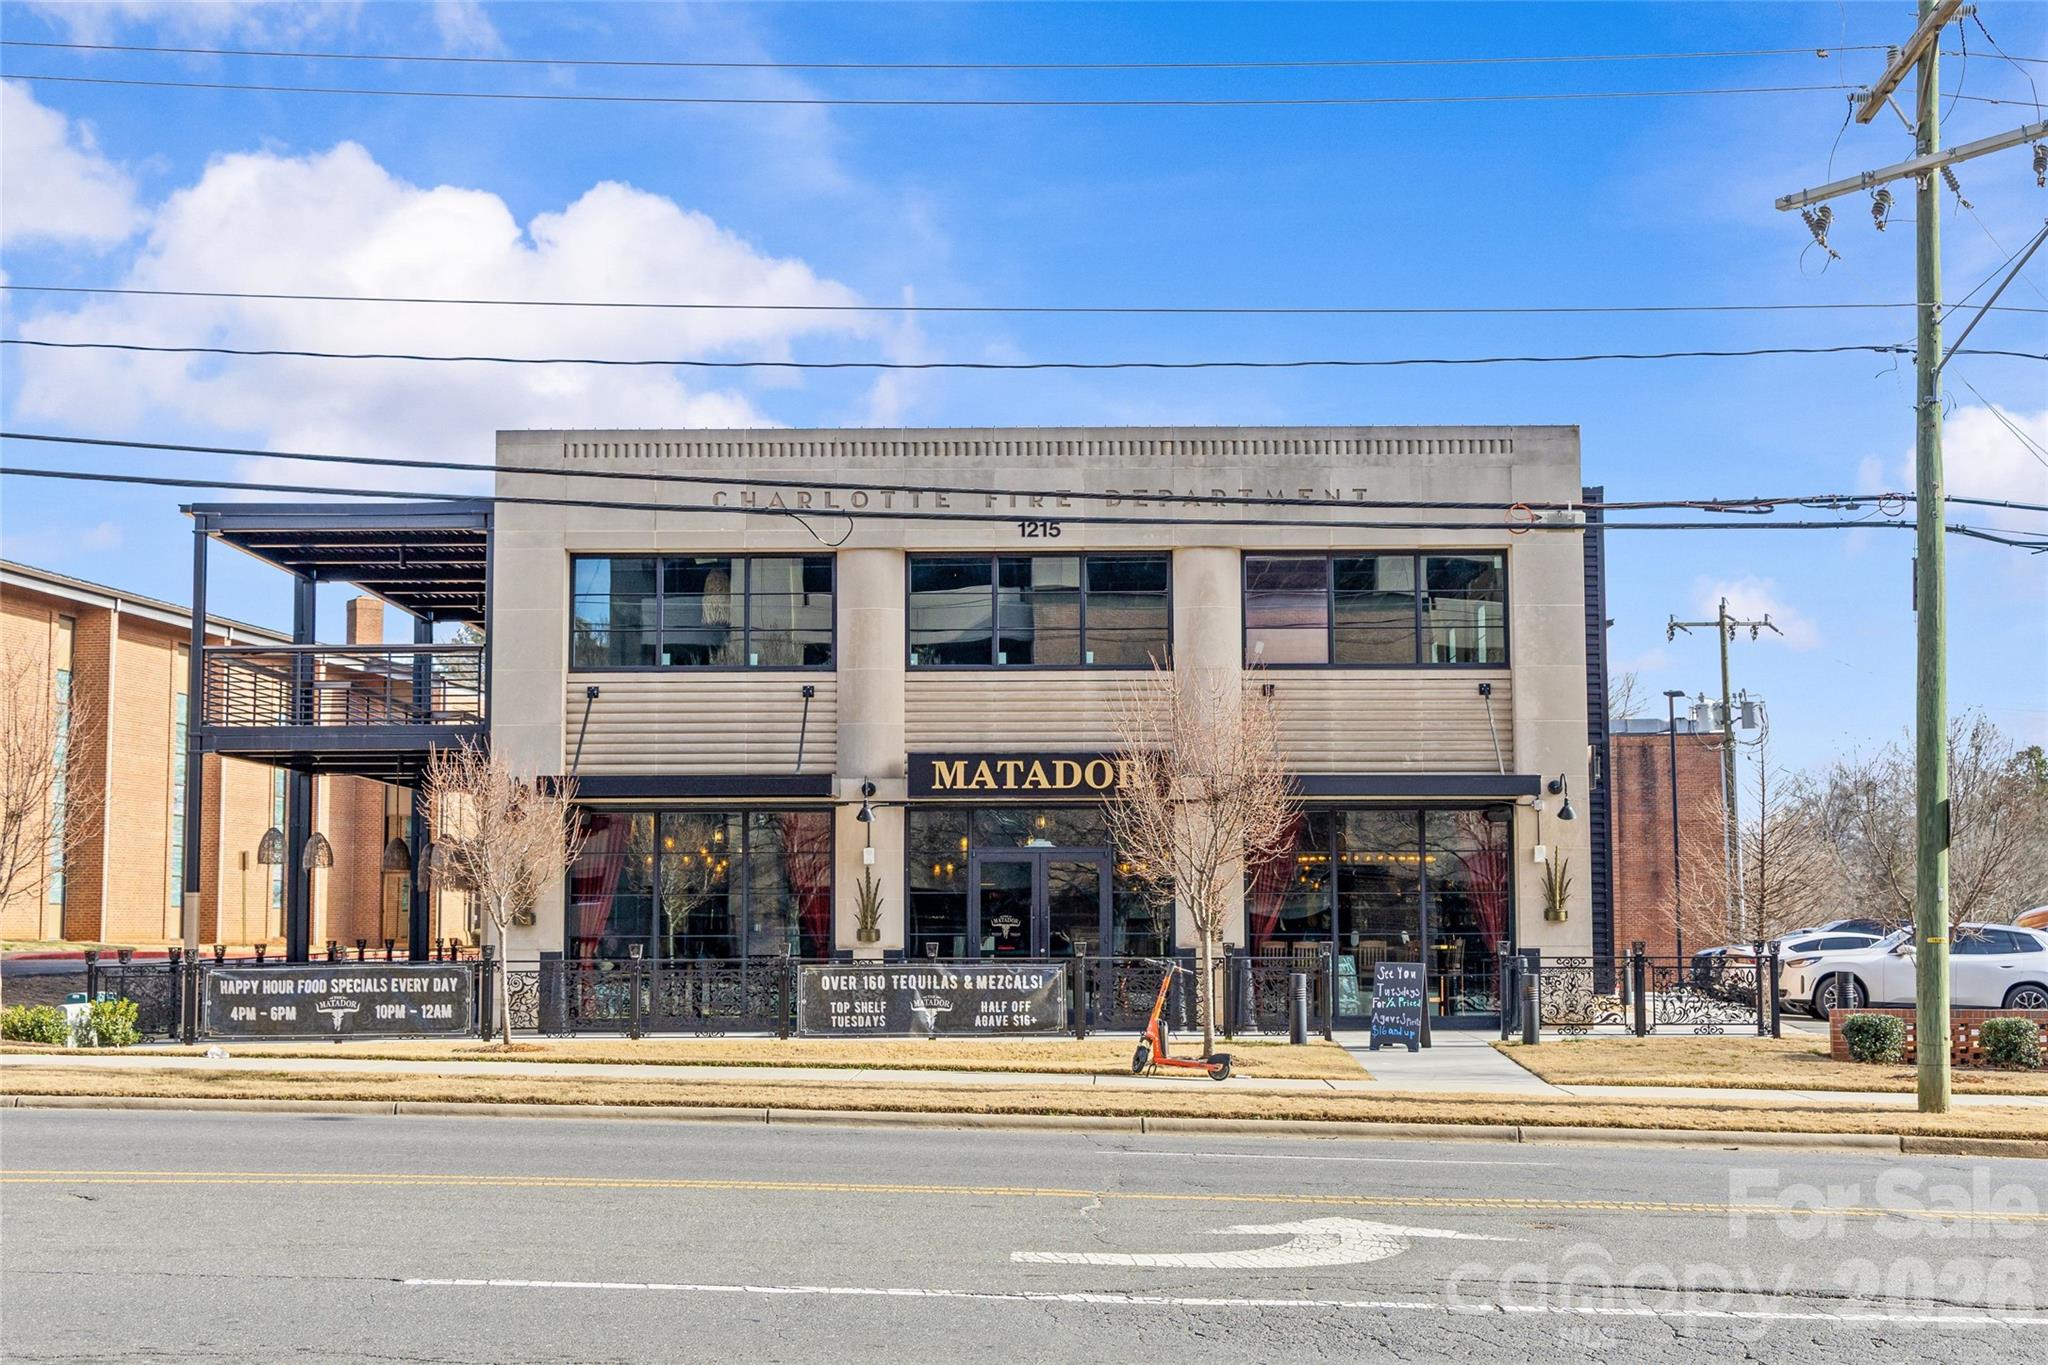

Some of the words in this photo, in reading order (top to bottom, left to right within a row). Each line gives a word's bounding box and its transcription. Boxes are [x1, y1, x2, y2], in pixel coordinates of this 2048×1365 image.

[712, 490, 951, 509] CHARLOTTE
[984, 489, 1072, 508] FIRE
[1105, 488, 1368, 508] DEPARTMENT
[1017, 521, 1062, 539] 1215
[1376, 966, 1395, 980] See
[1397, 966, 1417, 980] You
[220, 979, 259, 995] HAPPY
[262, 979, 294, 995] HOUR
[297, 979, 328, 994] FOOD
[330, 977, 388, 994] SPECIALS
[391, 977, 430, 993] EVERY
[433, 977, 458, 993] DAY
[821, 975, 857, 991] OVER
[862, 975, 886, 990] 160
[891, 975, 958, 990] TEQUILAS
[963, 975, 974, 990] &
[976, 974, 1043, 990] MEZCALS!
[1376, 983, 1421, 998] Tuesdays
[319, 999, 357, 1009] MATADOR
[830, 1001, 850, 1014] TOP
[854, 1001, 887, 1013] SHELF
[913, 998, 950, 1008] MATADOR
[980, 1001, 1008, 1013] HALF
[1011, 1001, 1032, 1013] OFF
[1372, 997, 1386, 1009] For
[1398, 996, 1421, 1008] Priced
[230, 1006, 257, 1021] 4PM
[270, 1006, 297, 1021] 6PM
[375, 1004, 406, 1020] 10PM
[421, 1004, 452, 1019] 12AM
[830, 1015, 886, 1028] TUESDAYS
[974, 1015, 1008, 1027] AGAVE
[1012, 1014, 1038, 1027] $16+
[1403, 1028, 1416, 1039] up
